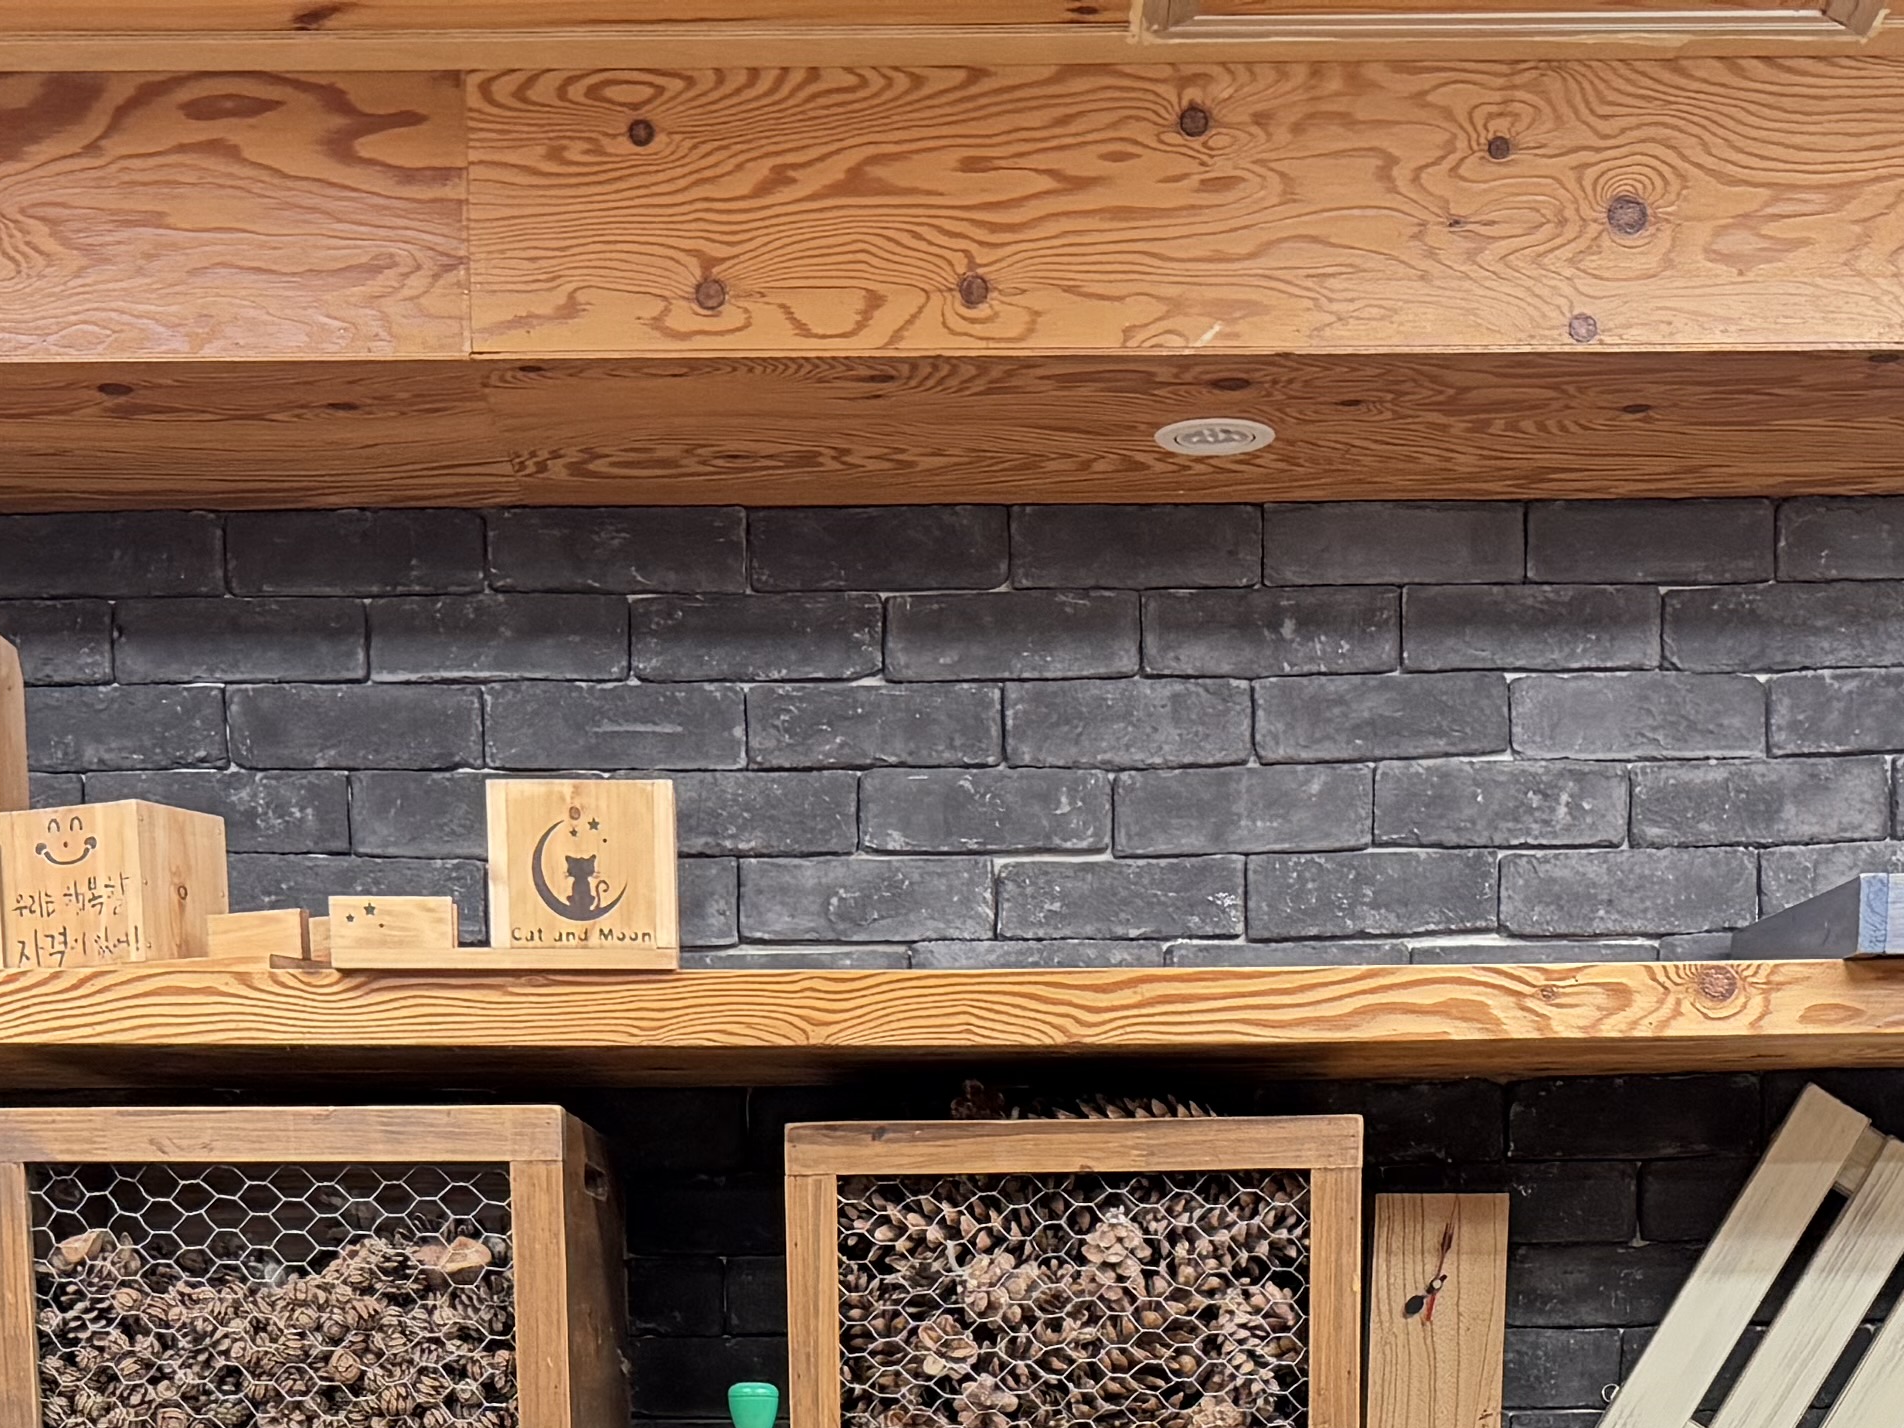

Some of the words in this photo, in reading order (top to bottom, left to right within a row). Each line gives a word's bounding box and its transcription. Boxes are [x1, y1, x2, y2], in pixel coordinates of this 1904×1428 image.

[11, 890, 56, 918] 우리는
[63, 871, 130, 917] 행복할
[16, 924, 88, 969] 자격이
[511, 926, 544, 943] Cat
[553, 927, 589, 943] and
[598, 927, 652, 943] Moon
